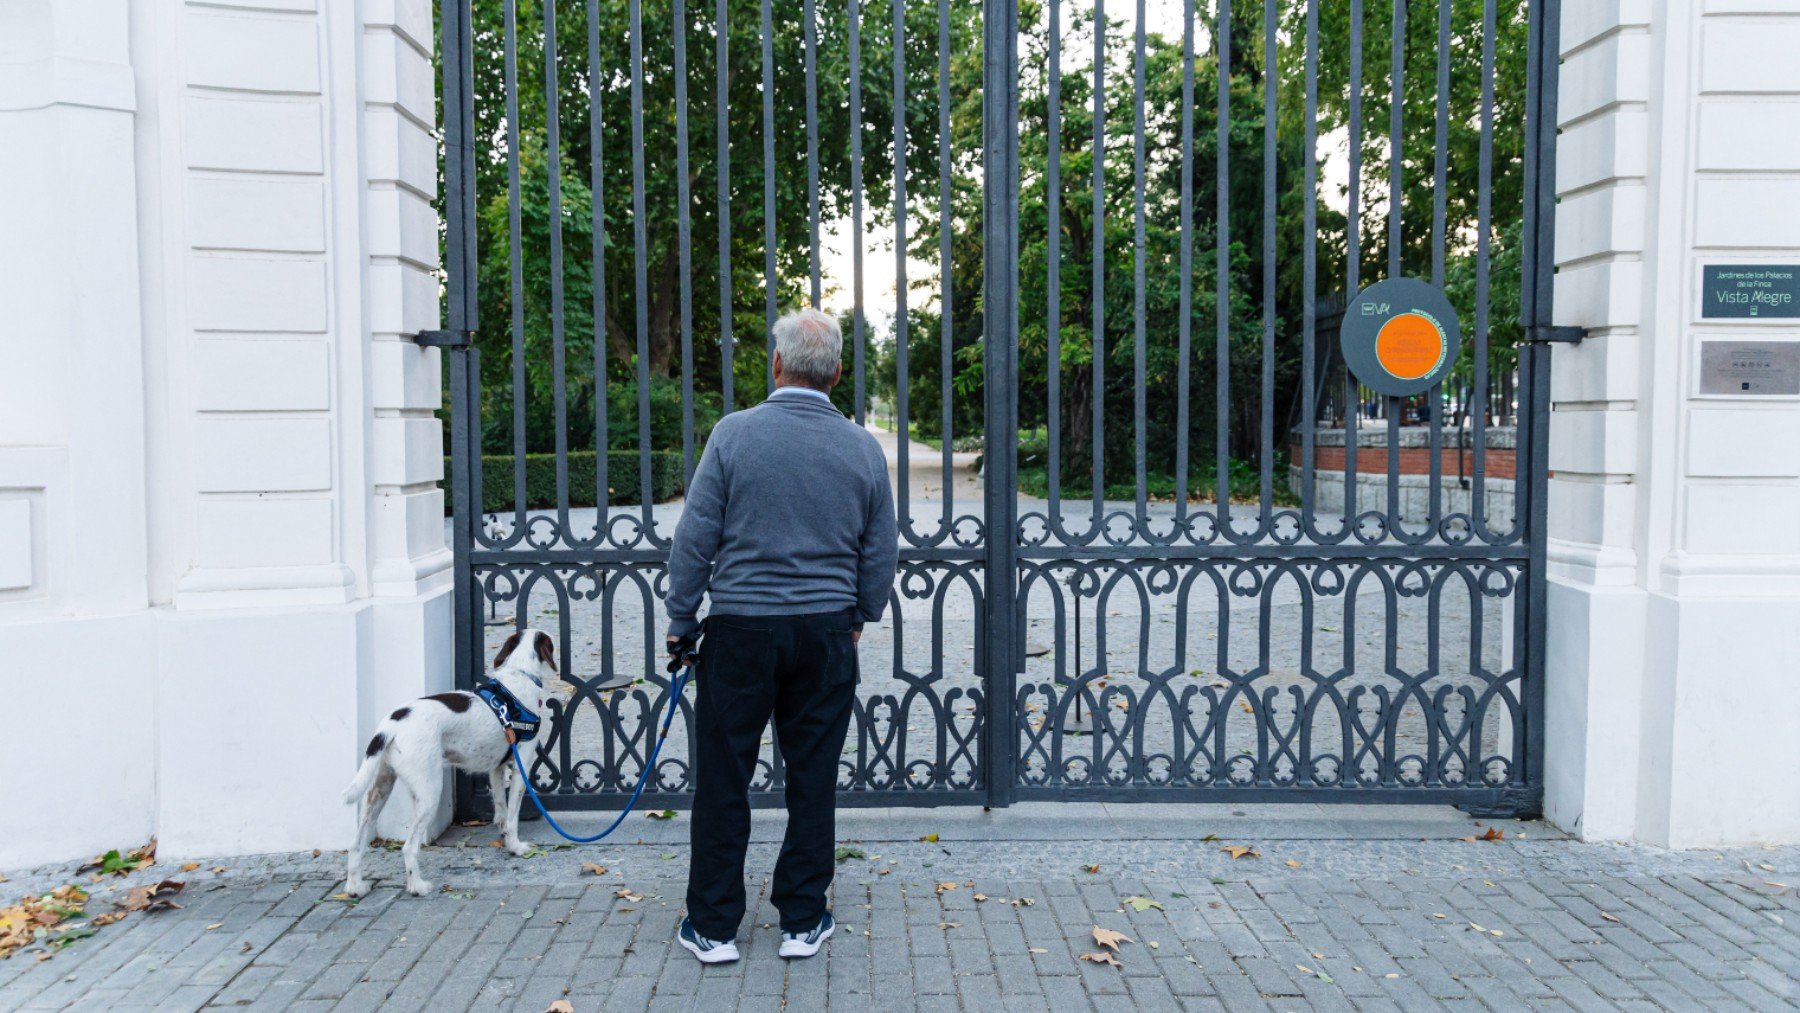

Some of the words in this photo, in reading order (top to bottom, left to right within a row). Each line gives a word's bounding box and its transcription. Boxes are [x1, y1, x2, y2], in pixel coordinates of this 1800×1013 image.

[1717, 271, 1745, 279] Jardines
[1765, 271, 1792, 279] Palacios
[1716, 290, 1749, 303] Vista
[1751, 290, 1792, 306] Alegre
